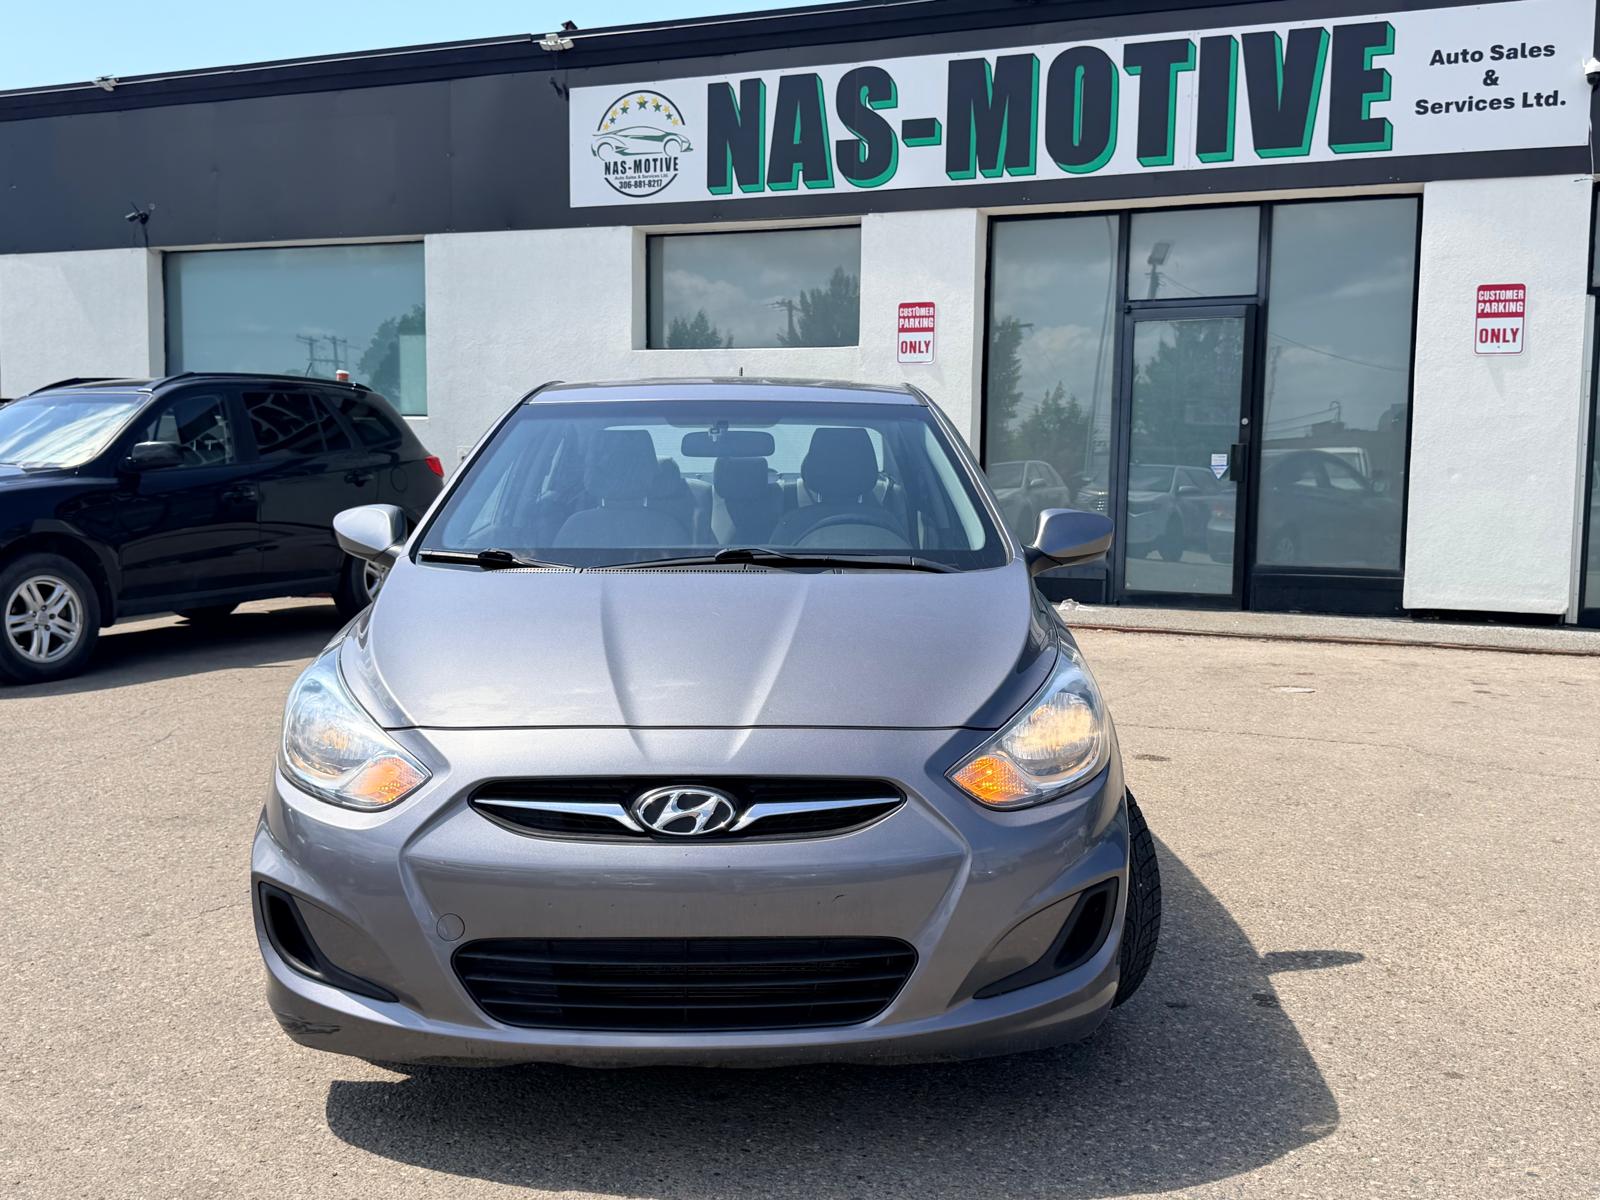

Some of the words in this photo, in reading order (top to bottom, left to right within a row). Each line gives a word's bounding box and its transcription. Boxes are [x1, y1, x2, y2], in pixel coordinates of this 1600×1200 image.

[1429, 49, 1484, 66] Auto
[1489, 43, 1556, 61] Sales
[1482, 69, 1499, 86] &
[707, 21, 1396, 195] NAS-MOTIVE
[1414, 96, 1515, 115] Services
[1522, 90, 1566, 108] Ltd.
[604, 157, 679, 175] NAS-MOTIVE
[619, 179, 663, 189] 306-881-8217
[1478, 290, 1524, 300] CUSTOMER
[900, 307, 934, 316] CUSTOMER
[1478, 301, 1524, 313] PARKING
[899, 318, 934, 328] PARKING
[1479, 327, 1520, 344] ONLY
[900, 340, 931, 354] ONLY
